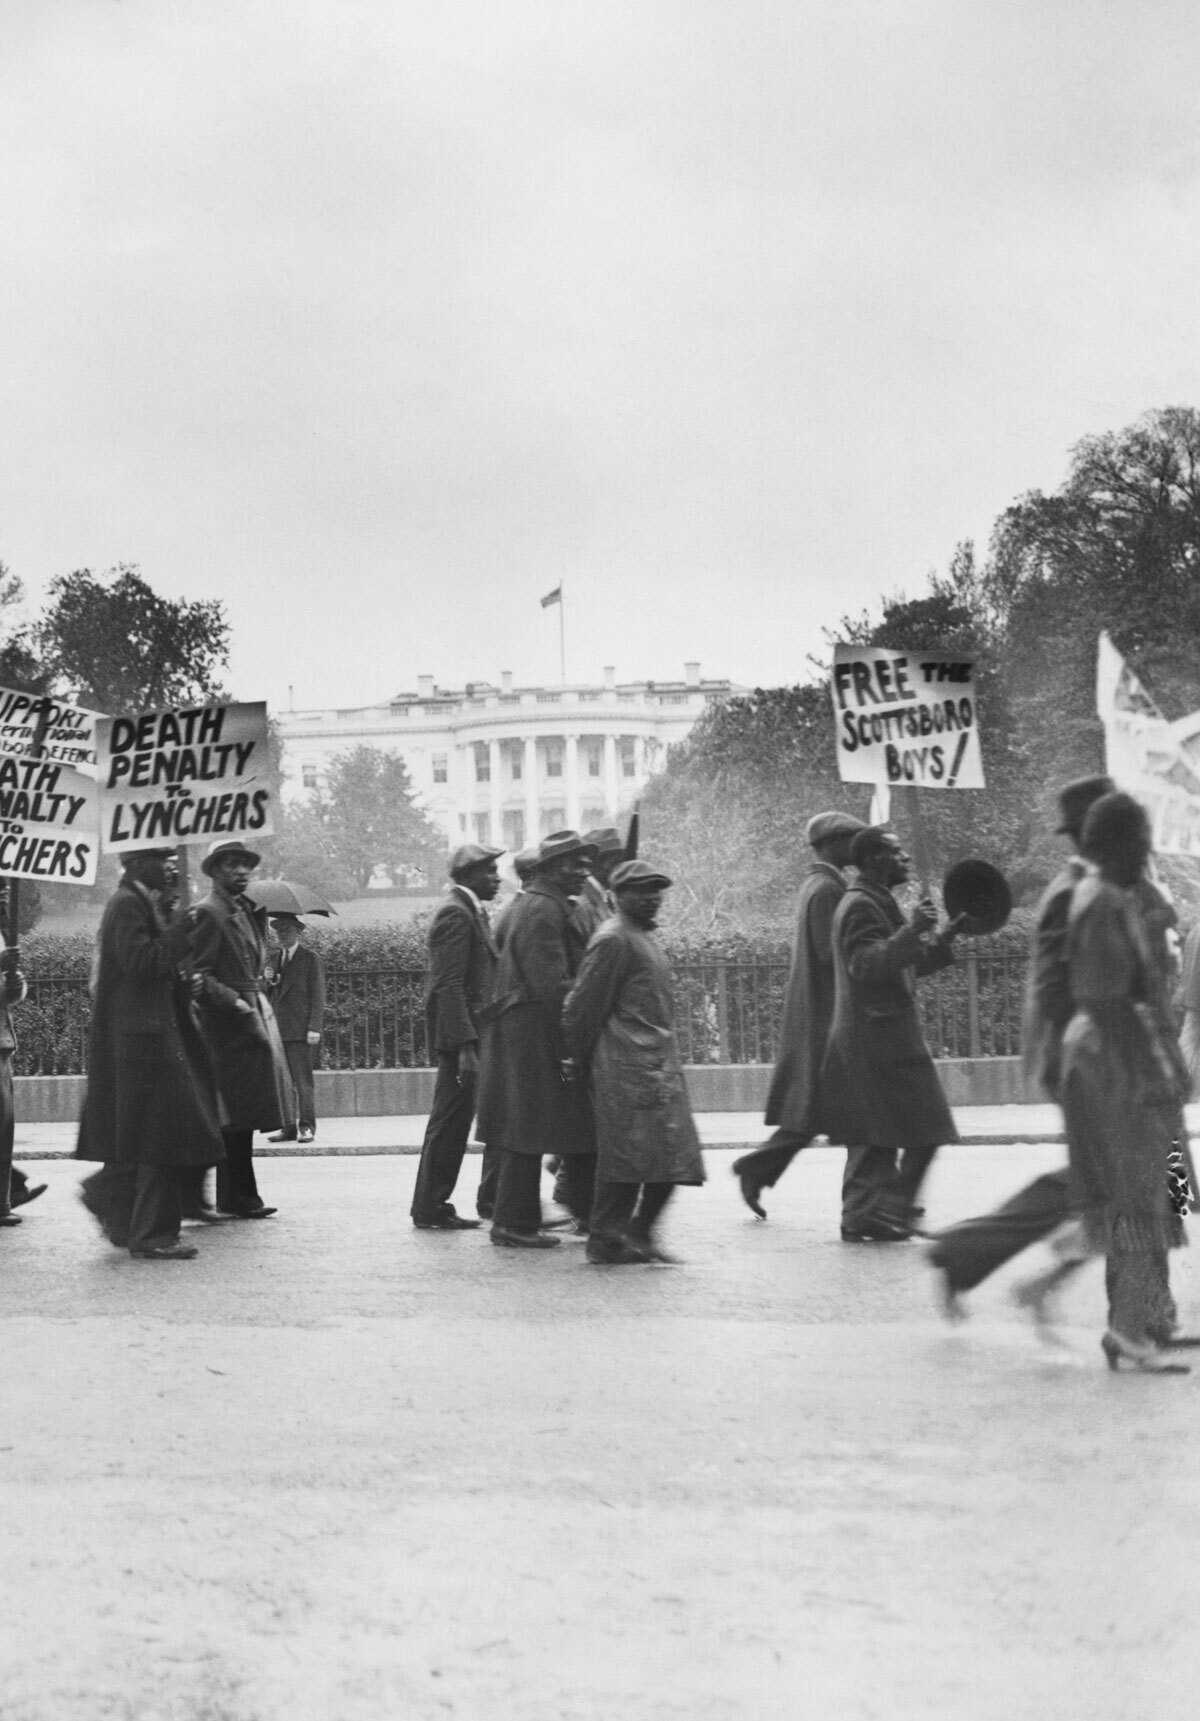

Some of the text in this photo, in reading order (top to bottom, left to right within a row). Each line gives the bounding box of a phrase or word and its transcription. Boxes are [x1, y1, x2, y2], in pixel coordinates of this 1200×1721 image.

[834, 658, 973, 709] FREE THE
[109, 707, 227, 755] DEATH
[841, 698, 973, 752] SCOTTSBORO
[106, 741, 256, 789] PENALTY
[886, 732, 968, 787] BOYS!
[109, 789, 270, 842] LYNCHERS
